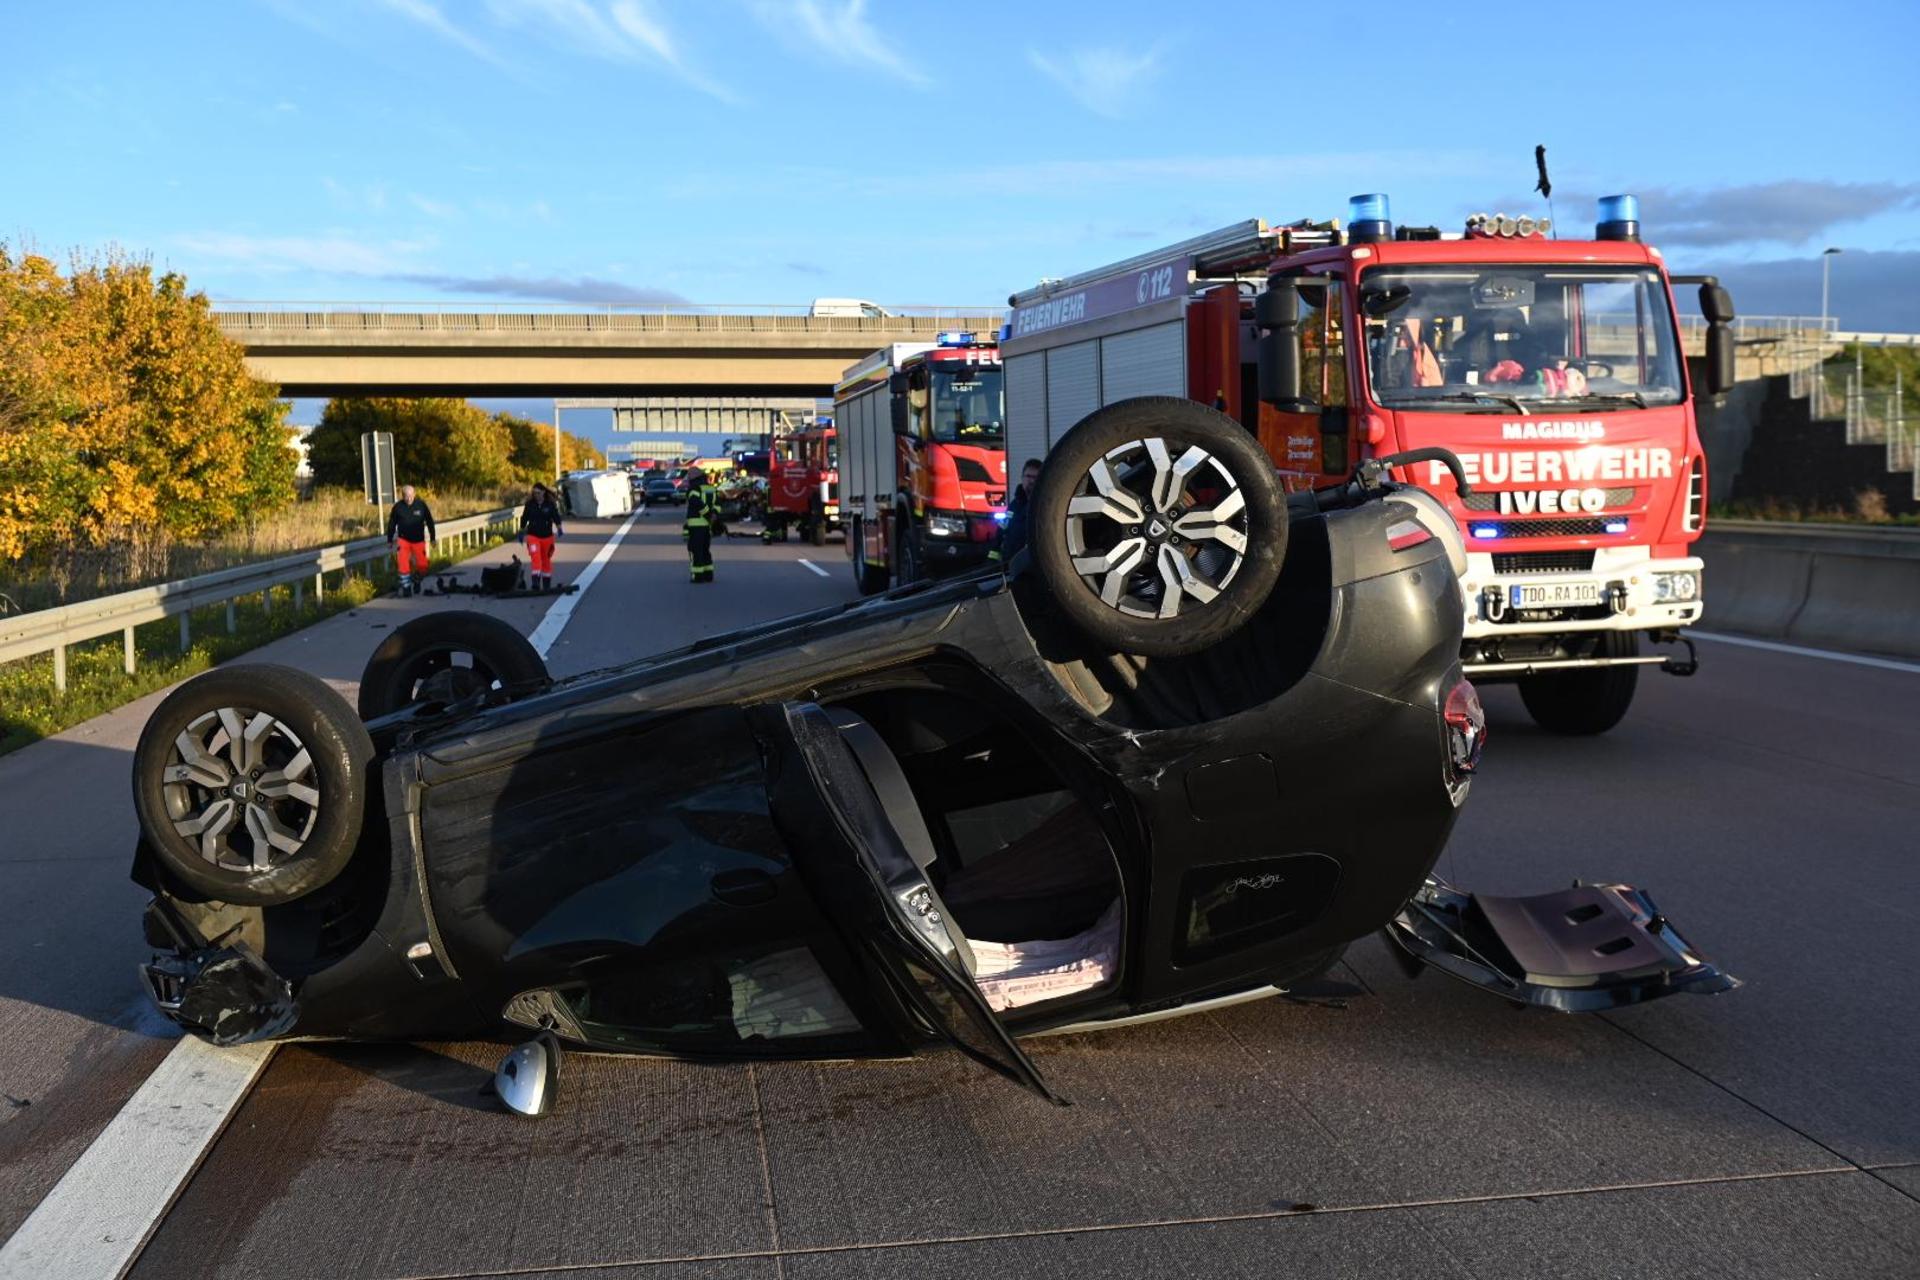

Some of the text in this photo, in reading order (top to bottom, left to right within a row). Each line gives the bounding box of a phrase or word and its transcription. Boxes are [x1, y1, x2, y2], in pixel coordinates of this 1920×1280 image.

[1151, 266, 1173, 299] 112
[1017, 293, 1086, 334] FEUERWEHR
[1503, 421, 1605, 440] MAGIRUS
[1429, 448, 1672, 486] FEUERWEHR
[1500, 489, 1606, 515] IVECO
[1521, 585, 1596, 602] TDO RA 101
